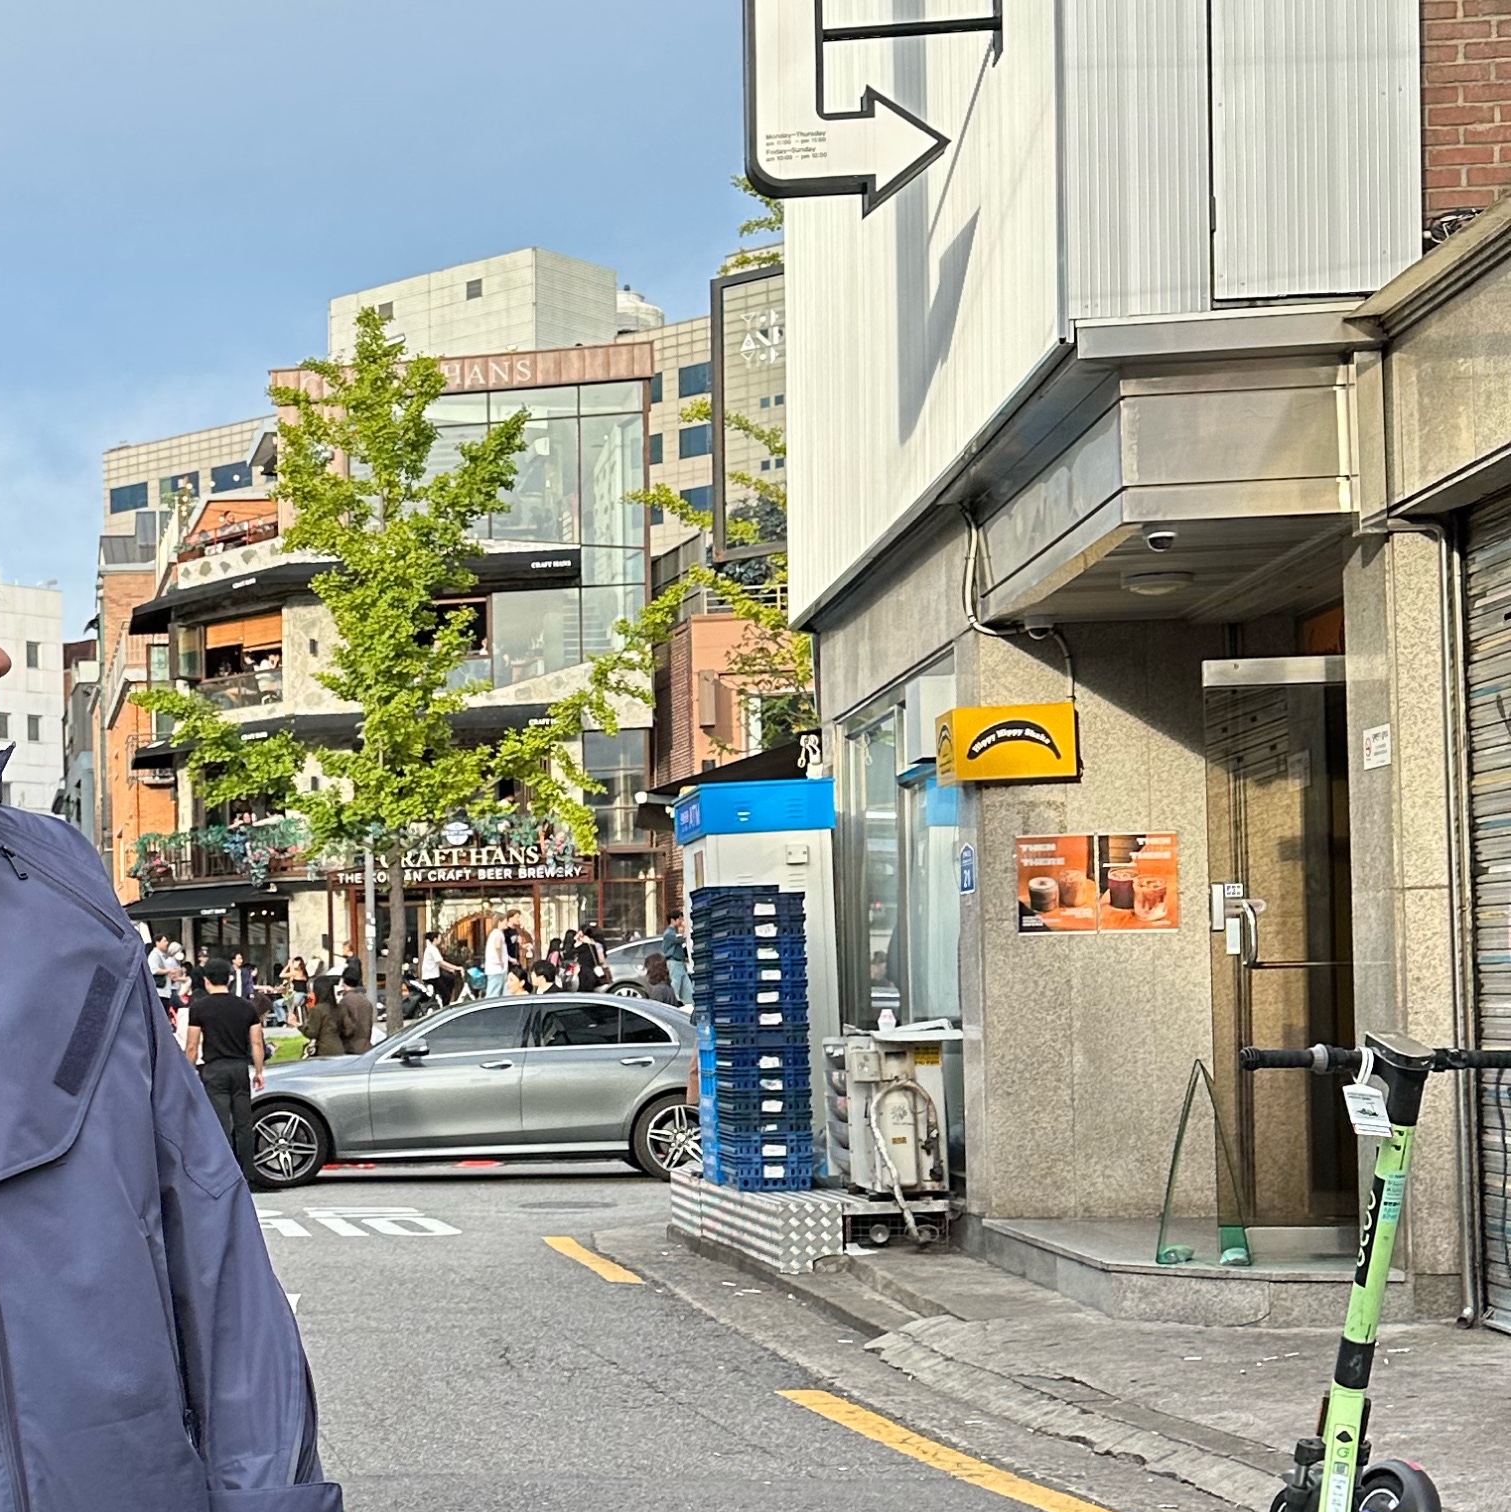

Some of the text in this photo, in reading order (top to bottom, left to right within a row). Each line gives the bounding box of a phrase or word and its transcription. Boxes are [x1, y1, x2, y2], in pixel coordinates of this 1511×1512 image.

[443, 359, 532, 386] HANS
[470, 846, 540, 866] HANS
[337, 872, 363, 884] THE
[428, 868, 472, 882] CRAFT
[478, 868, 512, 880] BEER
[518, 865, 582, 879] BREWERY
